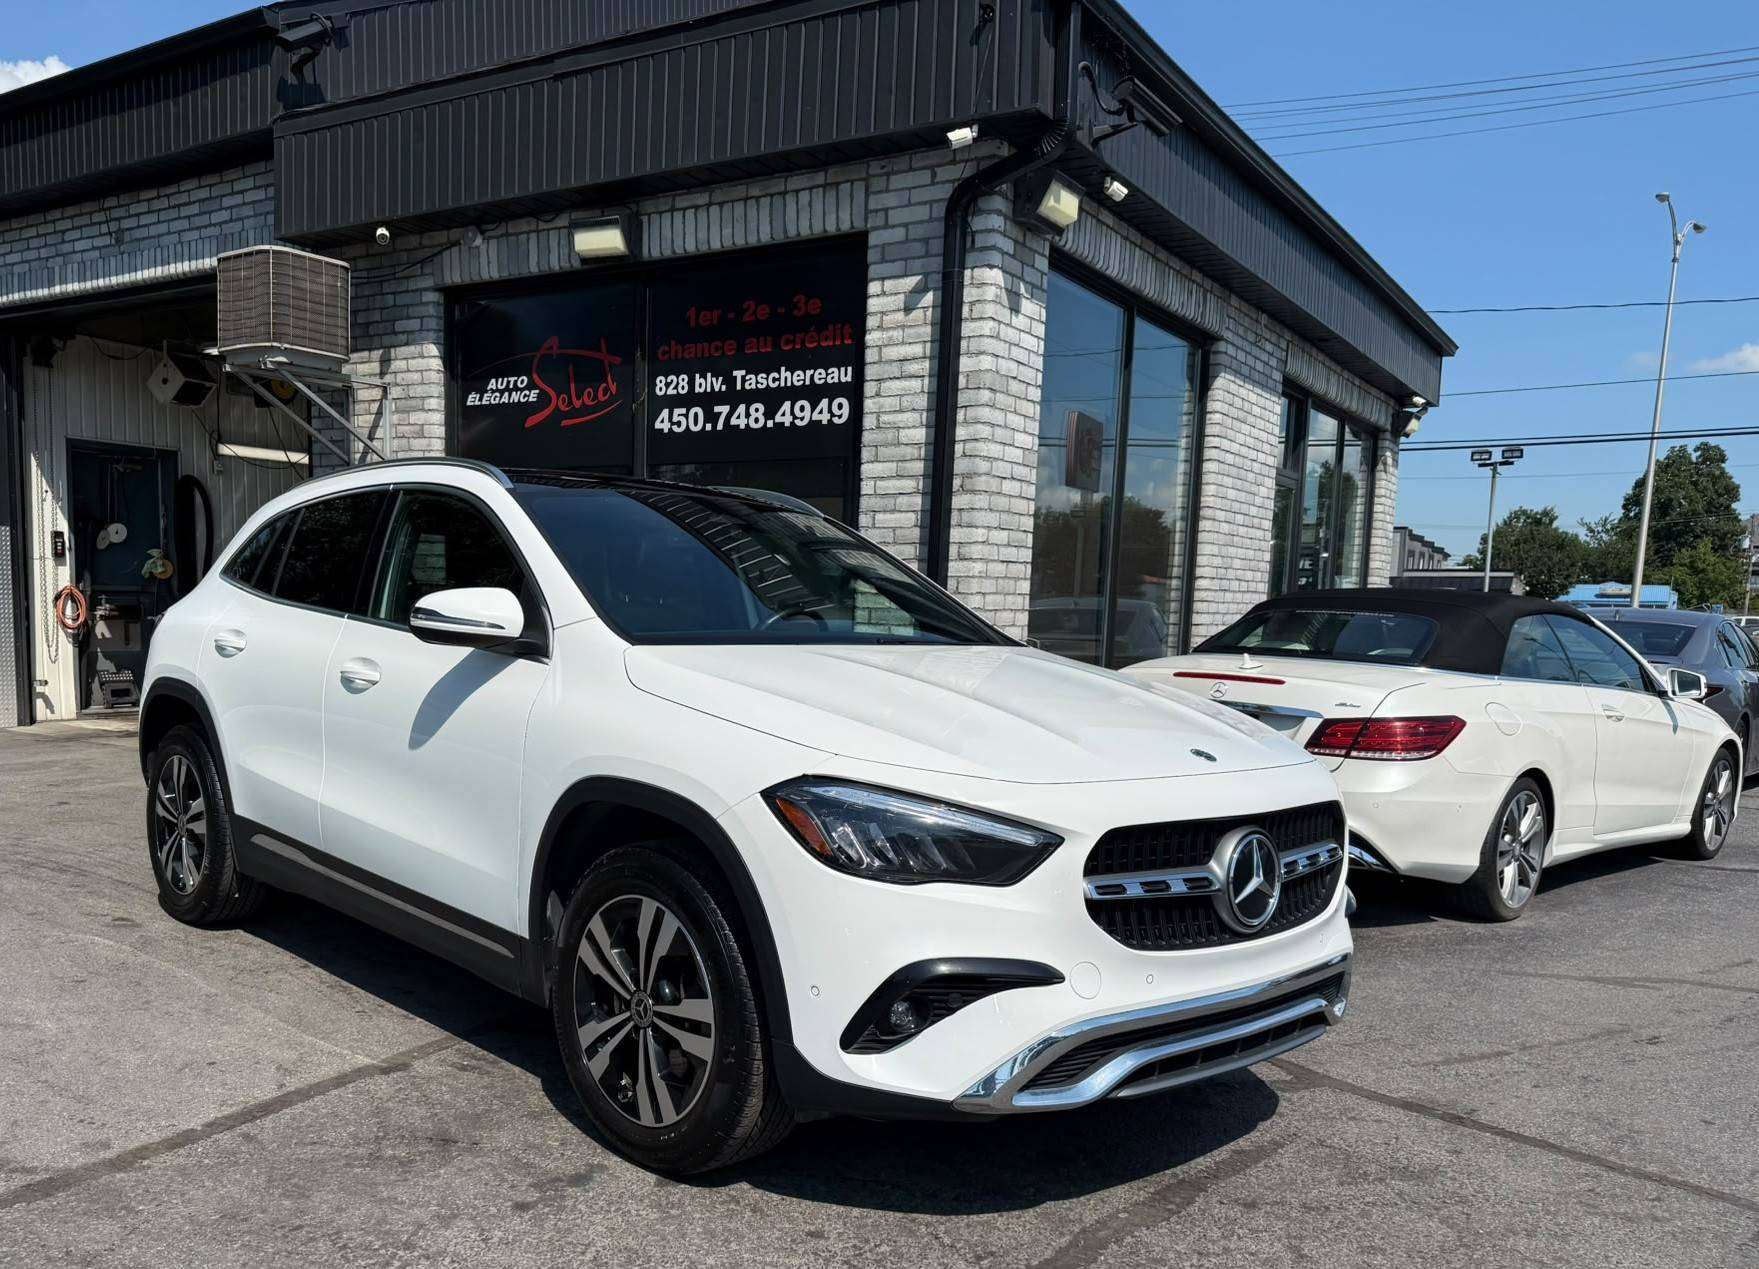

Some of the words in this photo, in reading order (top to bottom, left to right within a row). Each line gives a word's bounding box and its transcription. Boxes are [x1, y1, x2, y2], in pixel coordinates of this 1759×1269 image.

[687, 306, 722, 328] 1er
[742, 300, 770, 322] 2e
[792, 294, 822, 317] 3e
[657, 339, 738, 361] chance
[744, 334, 772, 354] au
[780, 323, 854, 350] crédit
[466, 389, 541, 406] ÉLÉGANCE
[486, 375, 529, 391] AUTO
[523, 335, 622, 428] Select
[655, 374, 689, 396] 828
[694, 372, 727, 393] blv.
[732, 366, 853, 391] Taschereau
[654, 397, 851, 434] 450.748.4949
